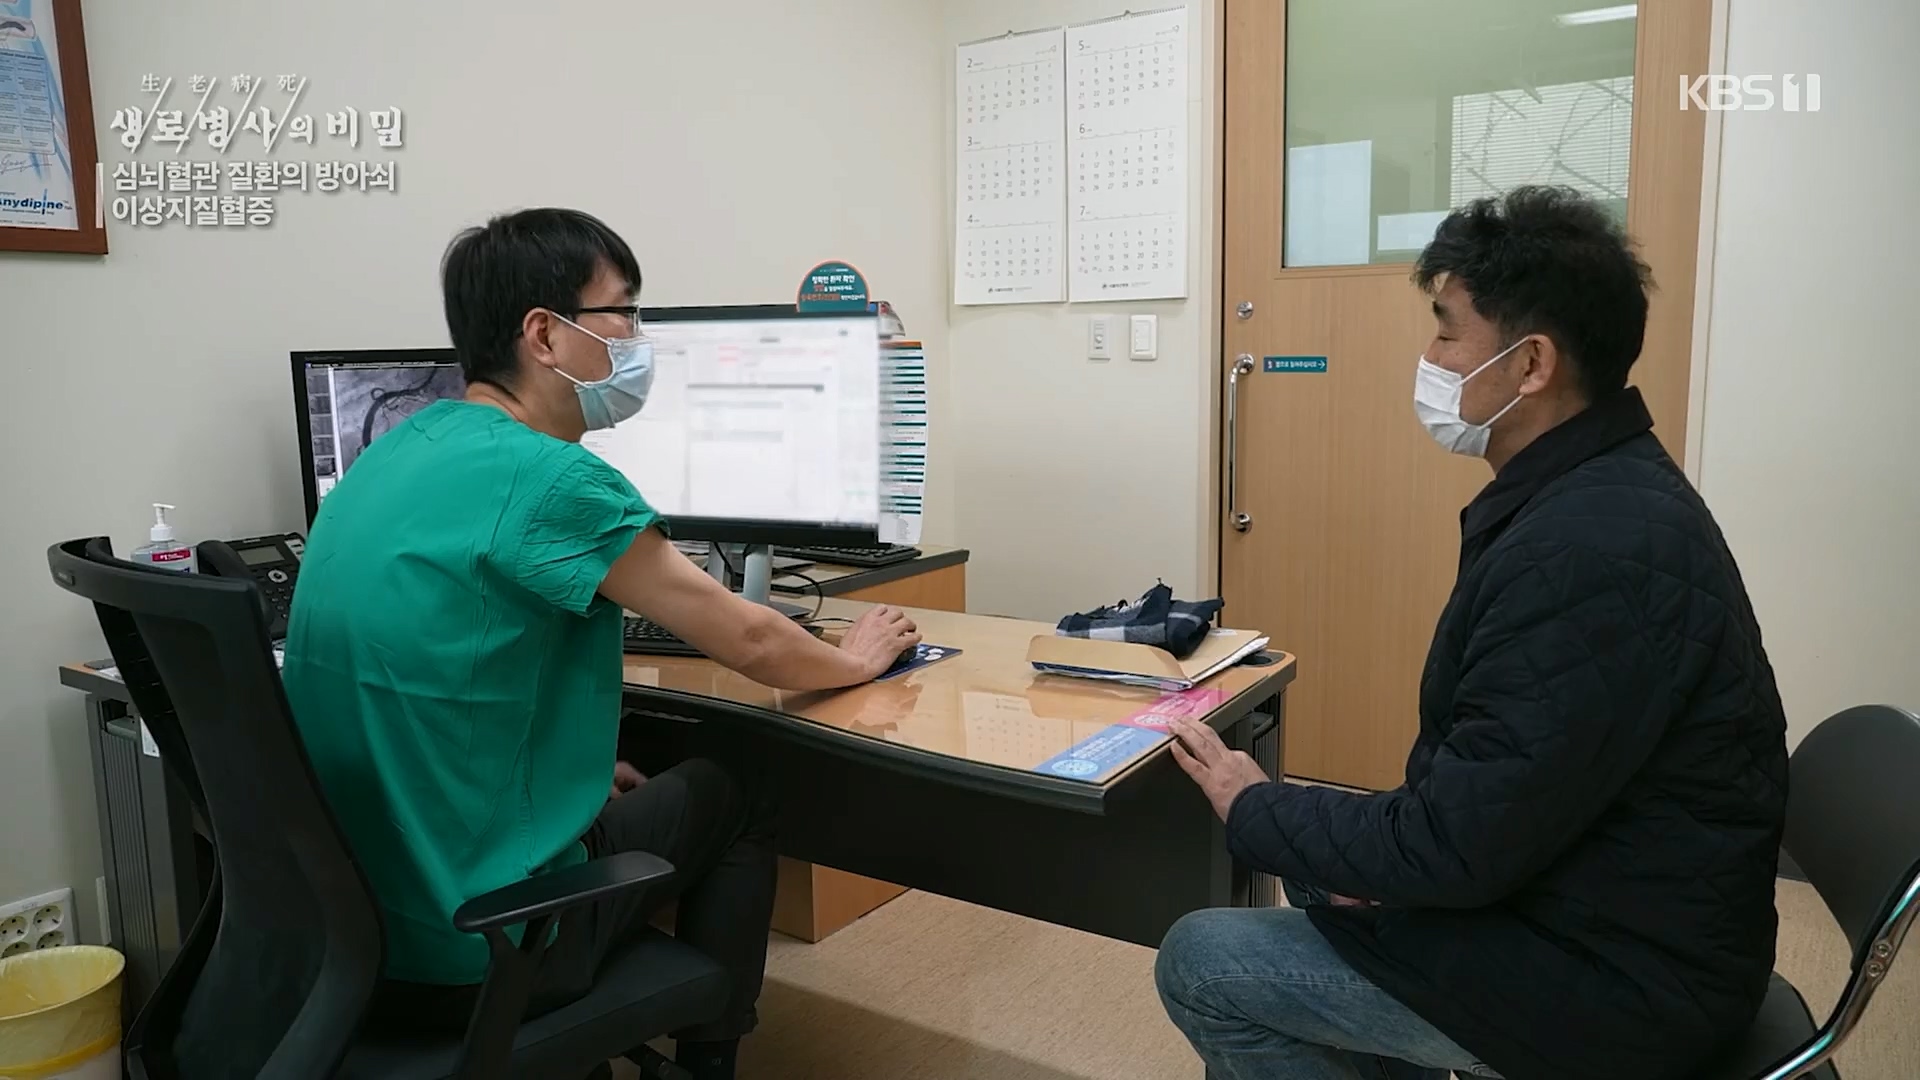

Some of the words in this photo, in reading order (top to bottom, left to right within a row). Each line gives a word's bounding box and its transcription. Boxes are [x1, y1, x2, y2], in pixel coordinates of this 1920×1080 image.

[1078, 40, 1084, 51] 5
[967, 58, 973, 68] 2
[1079, 123, 1085, 134] 6
[967, 136, 973, 146] 3
[1079, 205, 1086, 216] 7
